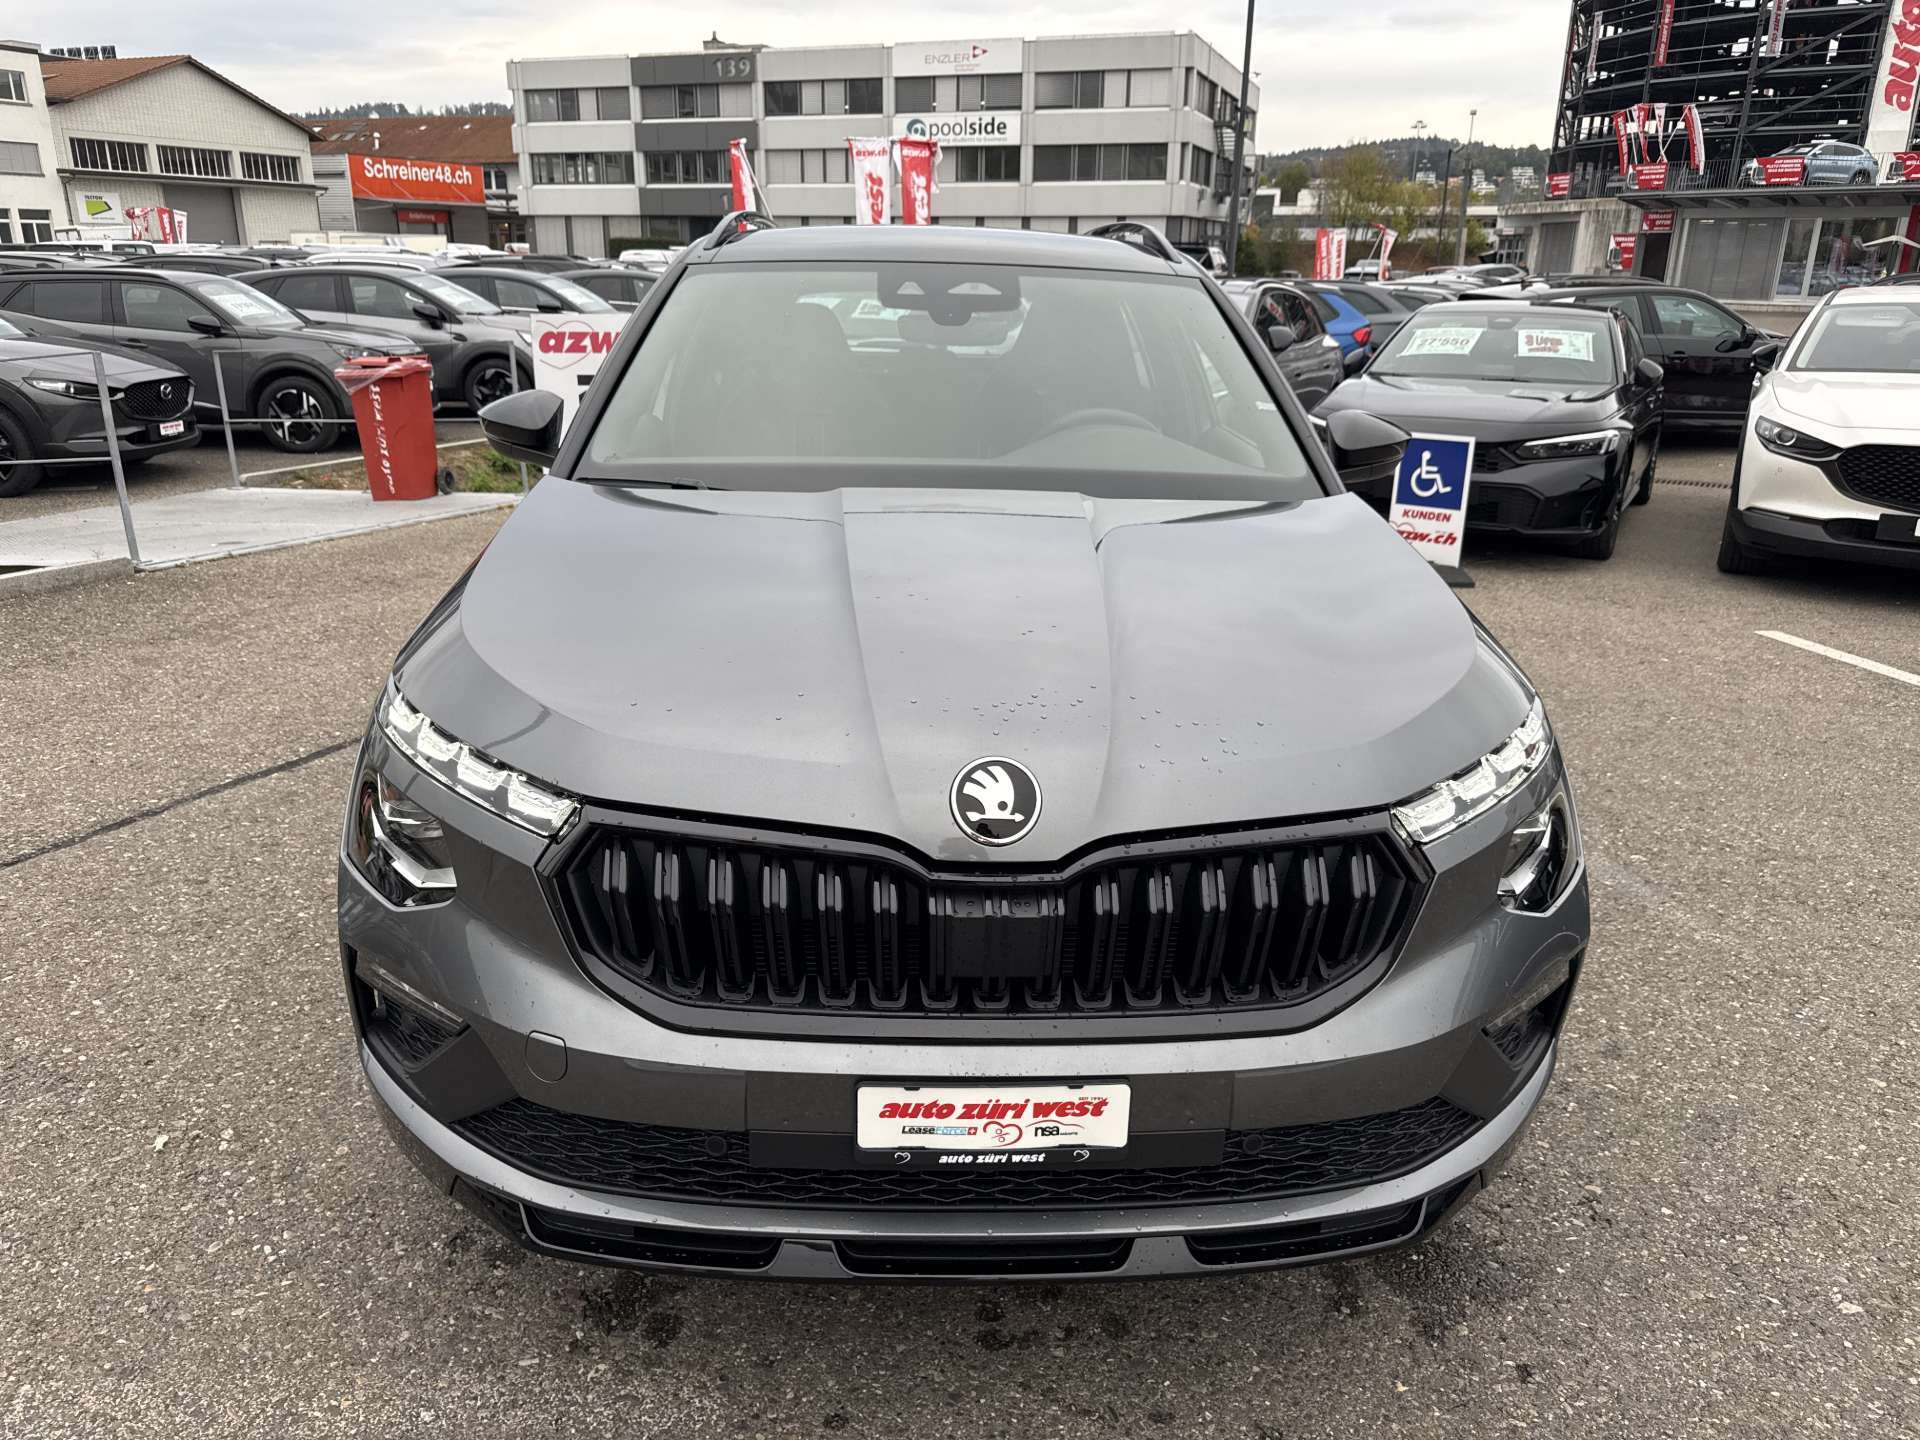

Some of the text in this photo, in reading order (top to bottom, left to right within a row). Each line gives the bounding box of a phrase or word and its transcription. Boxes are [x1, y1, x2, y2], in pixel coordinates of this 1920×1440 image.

[924, 53, 971, 65] ENZLER
[716, 58, 751, 77] 139
[929, 116, 1007, 140] poolside
[856, 147, 888, 157] azw.ch
[363, 157, 473, 185] Schreiner48.ch
[369, 384, 382, 421] west
[380, 459, 396, 495] auto
[1402, 508, 1451, 522] KUNDEN
[879, 1098, 1109, 1119] auto züri west
[902, 1126, 967, 1135] LeaseForce
[1034, 1126, 1060, 1137] nsa
[939, 1152, 1046, 1164] auto züri west
